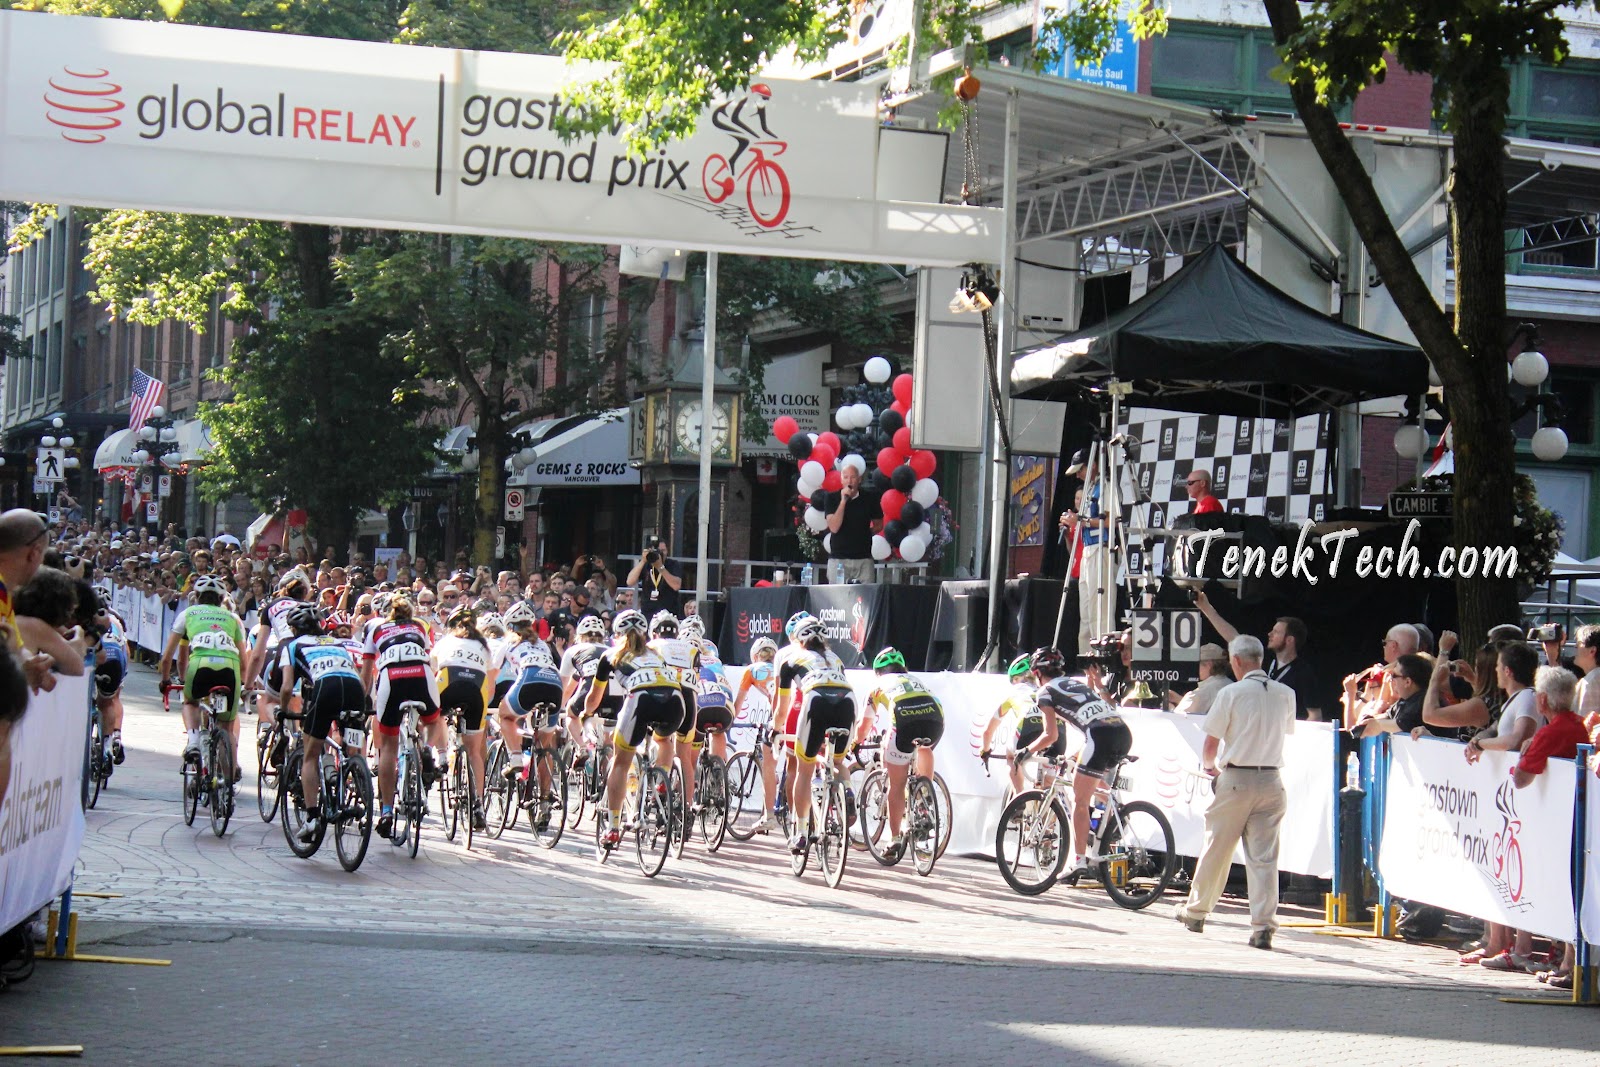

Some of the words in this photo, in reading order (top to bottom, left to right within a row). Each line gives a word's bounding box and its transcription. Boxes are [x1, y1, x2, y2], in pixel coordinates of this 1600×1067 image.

[1081, 66, 1103, 77] Marc
[1105, 67, 1123, 79] Saul
[461, 141, 597, 186] grand
[607, 150, 690, 196] prix
[753, 393, 777, 405] EAM
[781, 394, 820, 406] CLOCK
[779, 408, 820, 416] SOUVENIRS
[536, 463, 571, 475] GEMS
[574, 463, 583, 475] &
[587, 463, 628, 475] ROCKS
[1395, 497, 1438, 513] CAMBIE
[631, 672, 652, 687] 211
[1131, 670, 1152, 681] LAPS
[1153, 670, 1165, 681] TO
[1166, 670, 1179, 681] GO
[900, 706, 935, 716] COLAVITA
[1082, 701, 1103, 719] 220
[348, 731, 359, 745] 240
[1119, 777, 1129, 791] 220
[1464, 828, 1489, 866] prix
